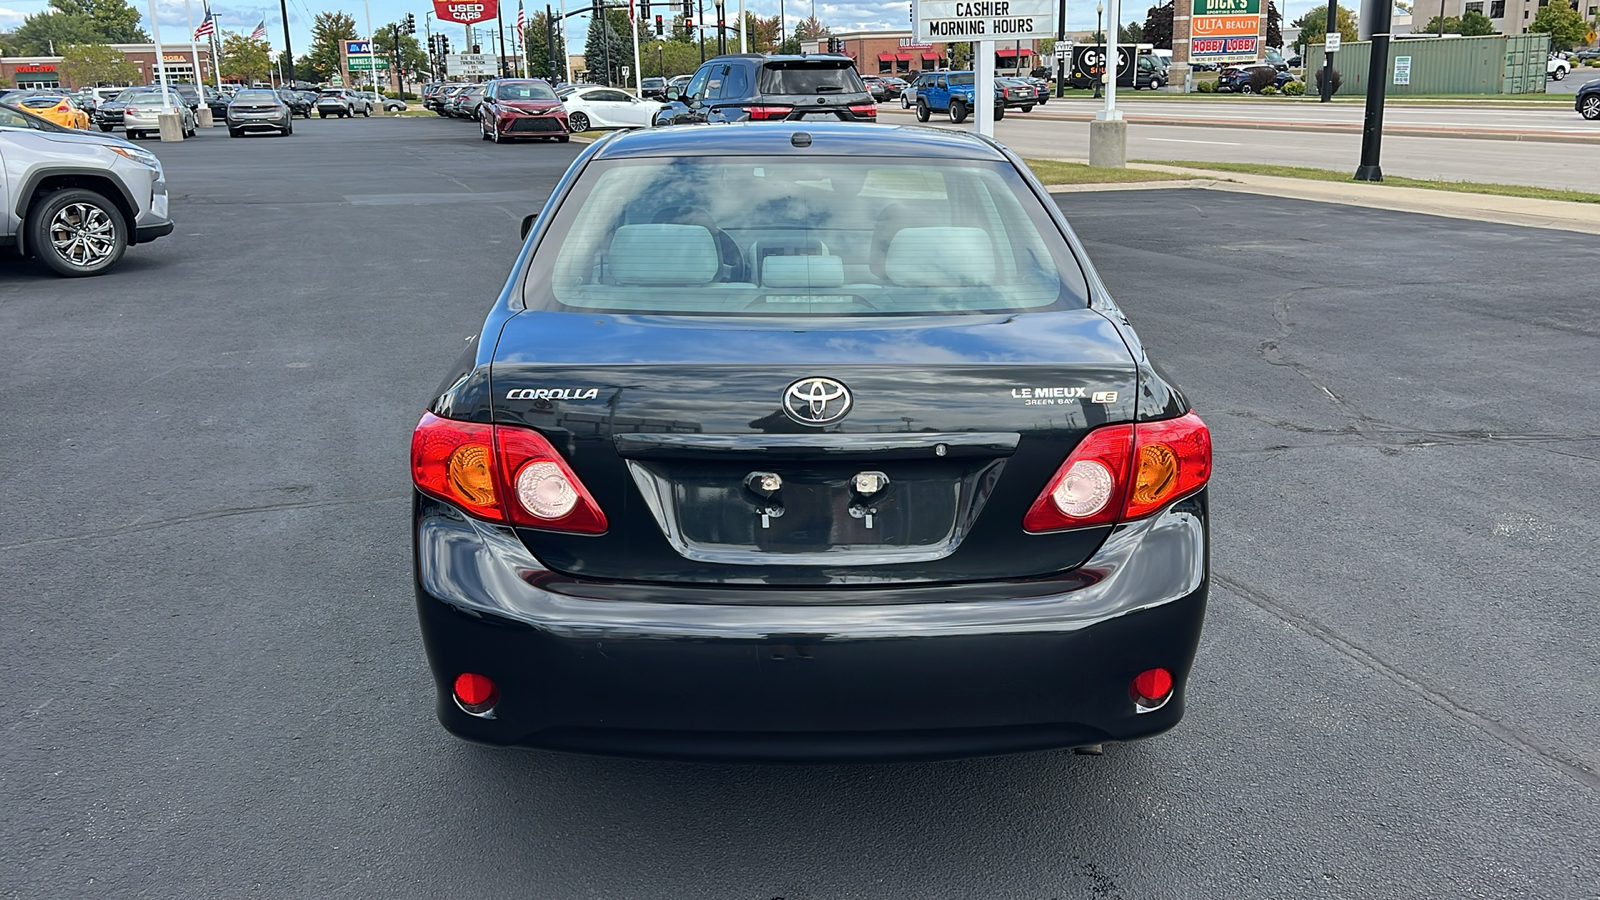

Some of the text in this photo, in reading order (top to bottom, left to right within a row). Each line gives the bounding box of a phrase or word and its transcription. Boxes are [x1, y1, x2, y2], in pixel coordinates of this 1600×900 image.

[448, 4, 484, 12] USED
[956, 1, 1009, 17] CASHIER
[1206, 0, 1248, 9] DICK'S
[452, 12, 481, 21] CARS
[929, 18, 1033, 36] MORNING HOURS
[1196, 18, 1257, 31] ULTA BEAUTY
[360, 43, 380, 52] ALD
[1192, 38, 1256, 53] HOBBY LOBBY
[1084, 50, 1124, 66] Gek
[506, 388, 598, 402] COROLLA
[1011, 387, 1087, 399] LE MIEUX
[1092, 391, 1117, 403] LE
